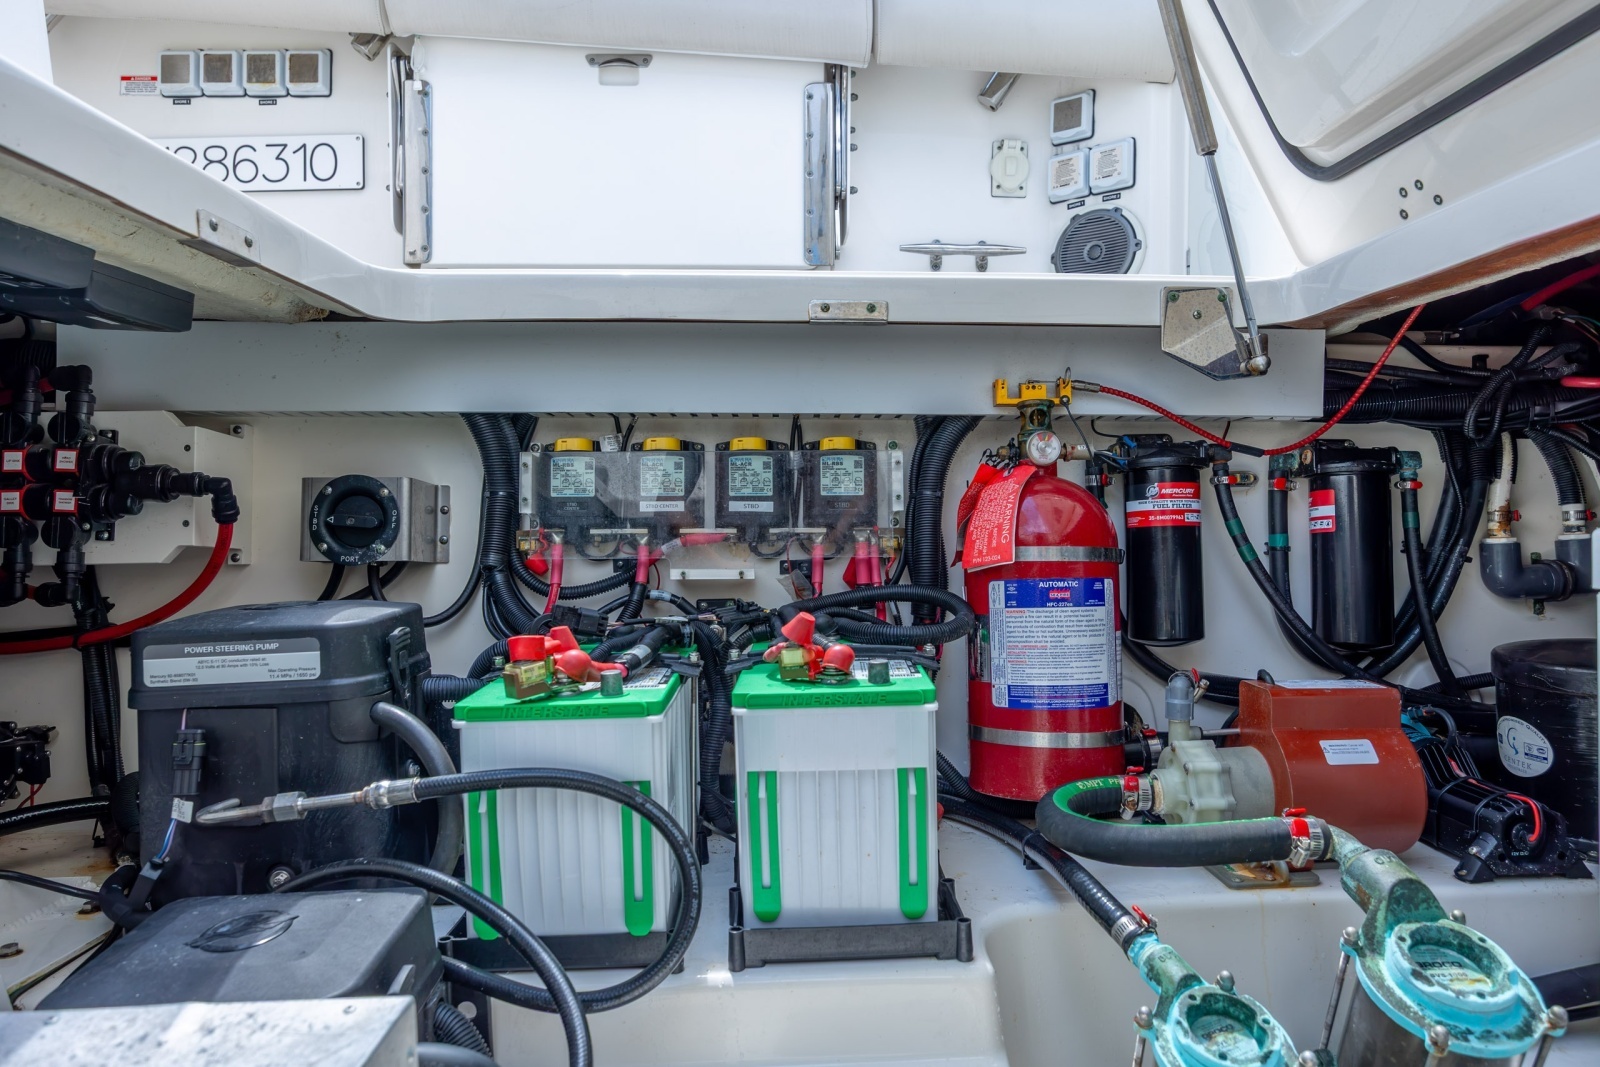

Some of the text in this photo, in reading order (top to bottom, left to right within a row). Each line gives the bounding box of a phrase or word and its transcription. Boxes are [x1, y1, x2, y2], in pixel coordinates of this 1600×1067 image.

[164, 142, 338, 184] 86310
[1001, 493, 1016, 544] WARNING
[184, 642, 280, 654] POWER STEERING PUMP
[782, 693, 888, 706] INTERSTATE
[502, 706, 609, 718] INTERSTATE
[1526, 724, 1548, 745] QUALITY
[1504, 754, 1533, 770] CENTEK
